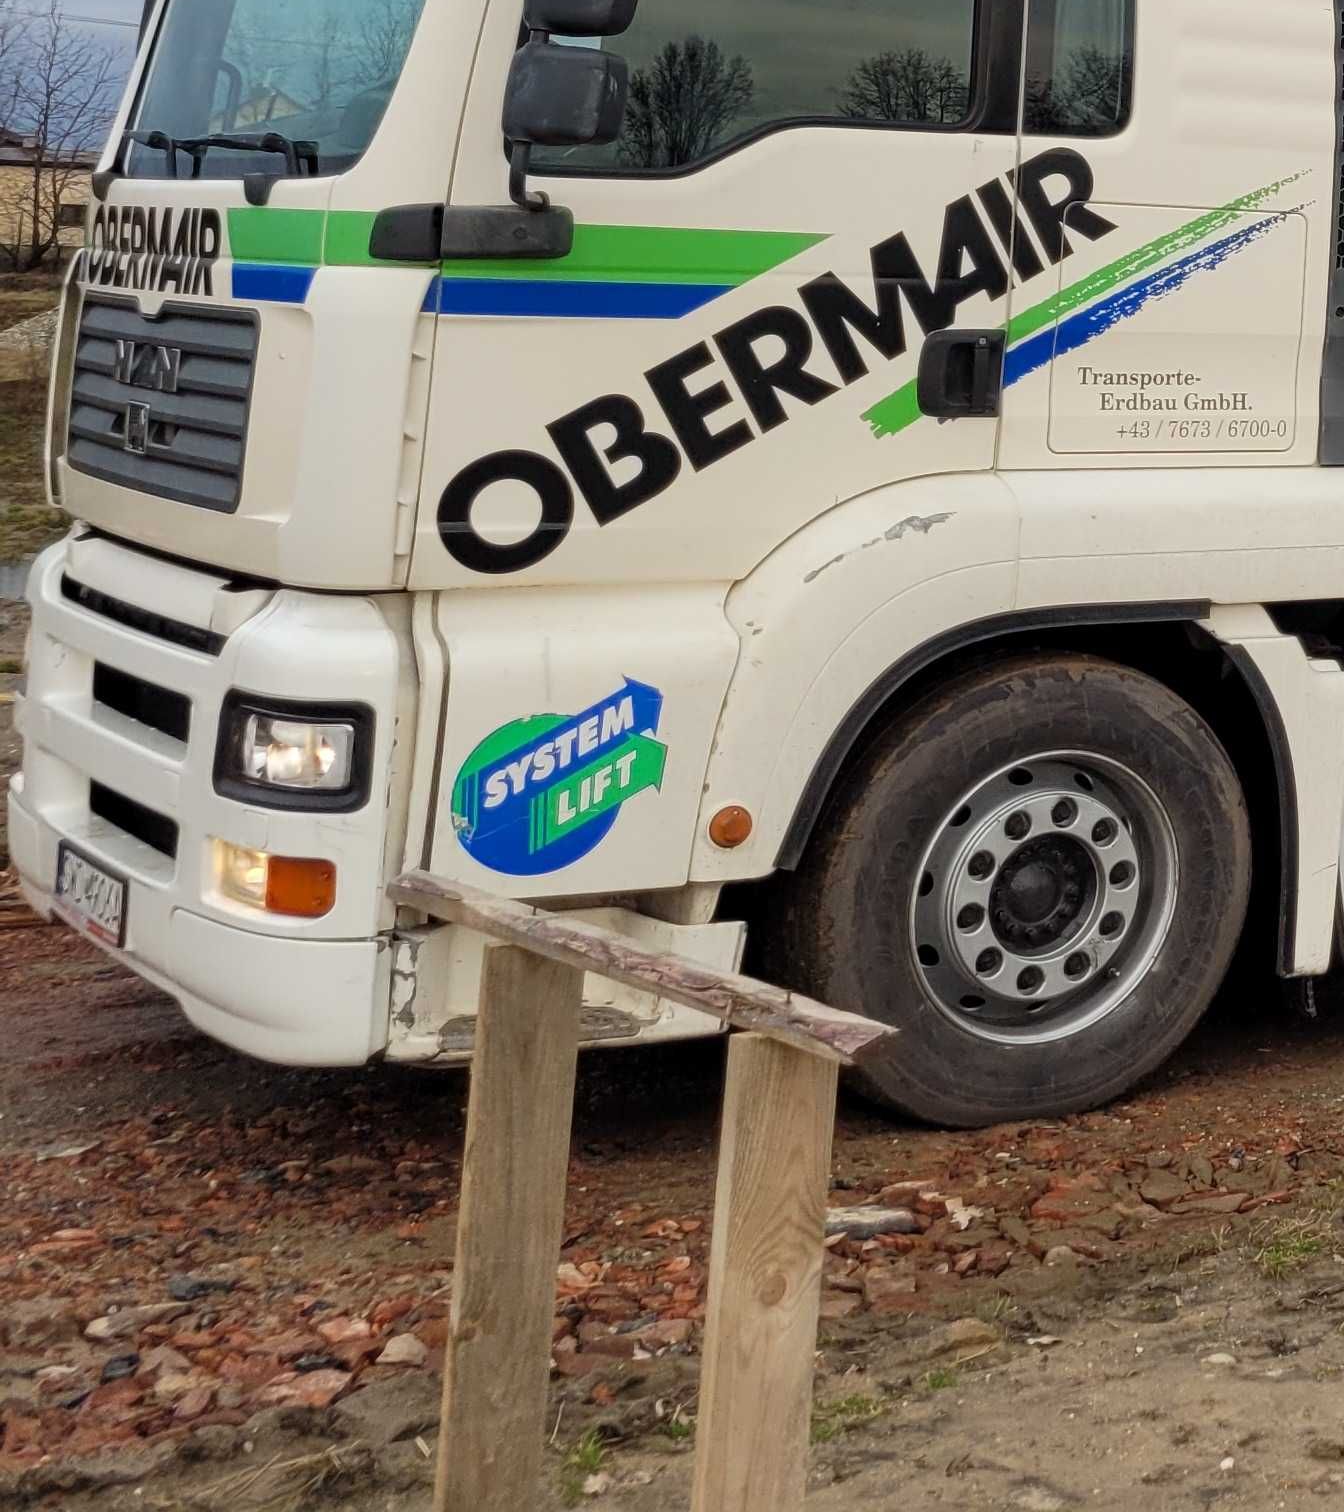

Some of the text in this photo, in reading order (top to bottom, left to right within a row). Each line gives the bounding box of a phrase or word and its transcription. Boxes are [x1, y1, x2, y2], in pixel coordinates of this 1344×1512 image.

[89, 204, 222, 297] OBERMAIR
[114, 339, 182, 393] MAN
[436, 147, 1119, 574] OBERMAIR
[1077, 366, 1201, 389] Transporte-
[1099, 392, 1253, 411] Erdbau GmbH.
[1116, 419, 1151, 439] +43
[1168, 419, 1211, 438] 7673
[1228, 419, 1287, 438] 6700-0
[483, 695, 634, 808] SYSTEM
[557, 750, 637, 826] LIFT
